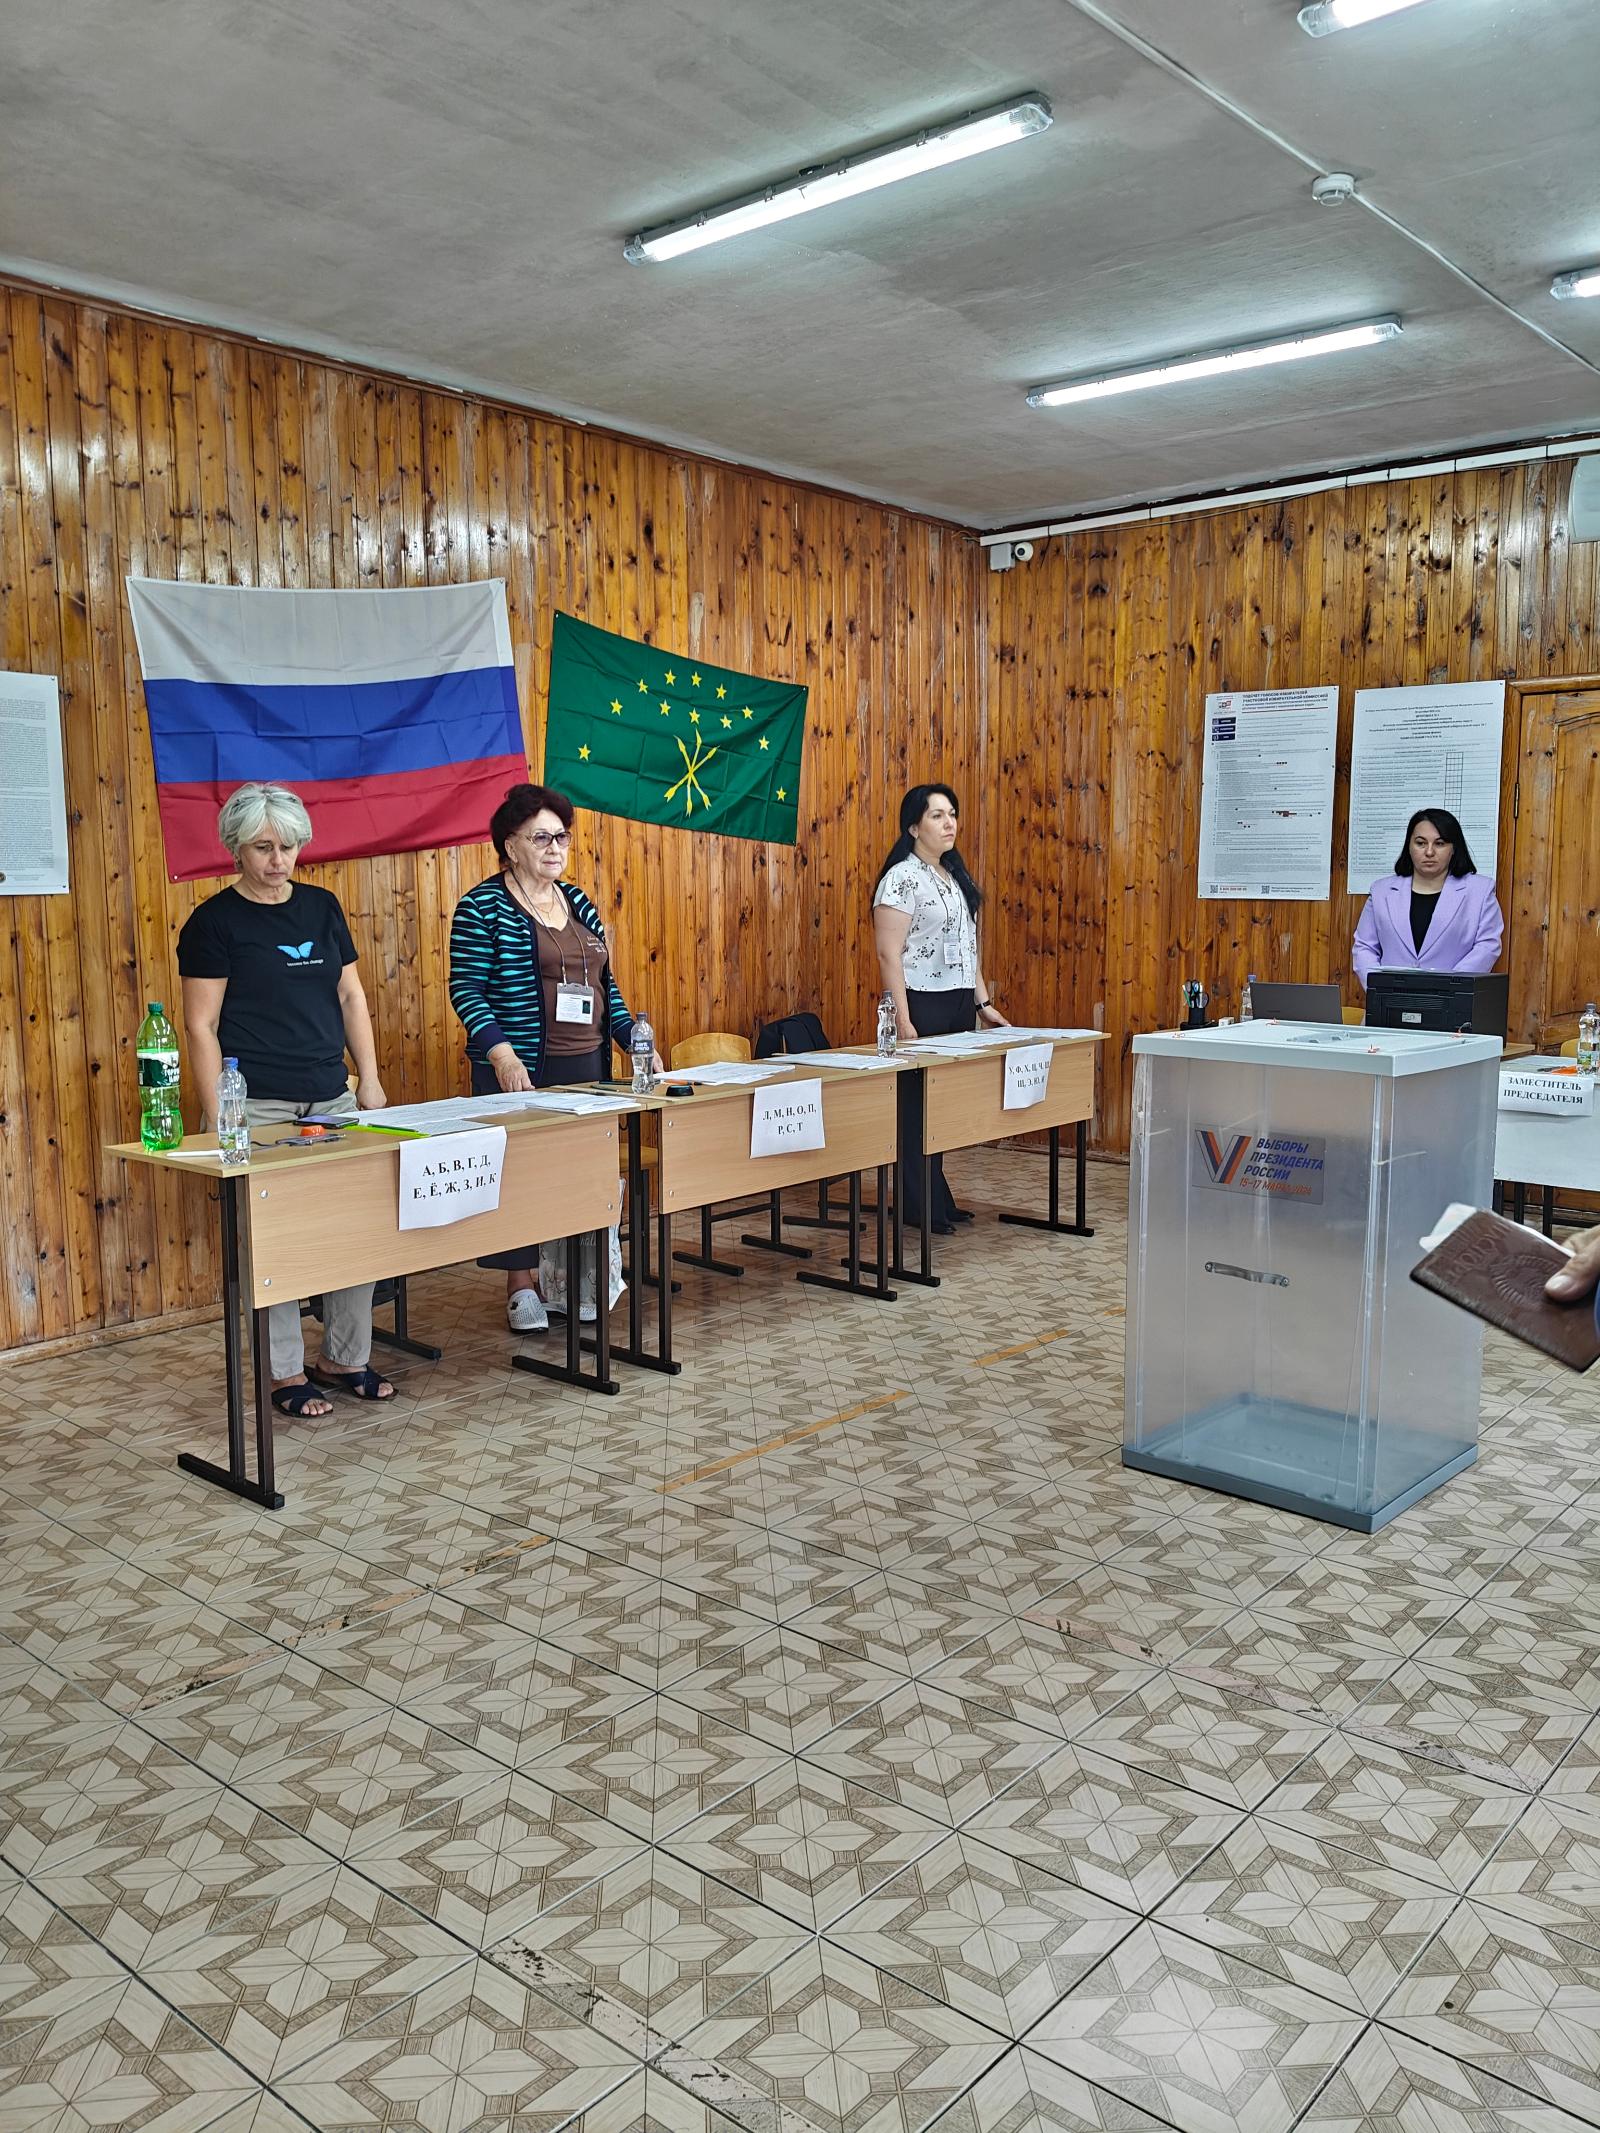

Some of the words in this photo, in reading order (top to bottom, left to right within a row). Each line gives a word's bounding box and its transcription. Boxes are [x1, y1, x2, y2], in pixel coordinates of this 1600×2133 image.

[1507, 1076, 1582, 1091] ЗАМЕСТИТЕЛЬ
[1503, 1089, 1583, 1104] ПРЕДСЕДАТЕЛЯ
[796, 1123, 803, 1132] Т
[1256, 1137, 1308, 1153] ВЫБОРЫ
[422, 1165, 435, 1177] А,
[438, 1162, 450, 1174] Б,
[453, 1160, 465, 1172] В,
[468, 1157, 477, 1169] Г,
[480, 1155, 491, 1168] Д,
[1250, 1152, 1324, 1170] ПРЕЗИДЕНТА
[1244, 1165, 1291, 1180] РОССИИ
[413, 1188, 426, 1200] Е,
[445, 1181, 460, 1194] Ж,
[463, 1180, 472, 1191] З,
[488, 1173, 497, 1184] К
